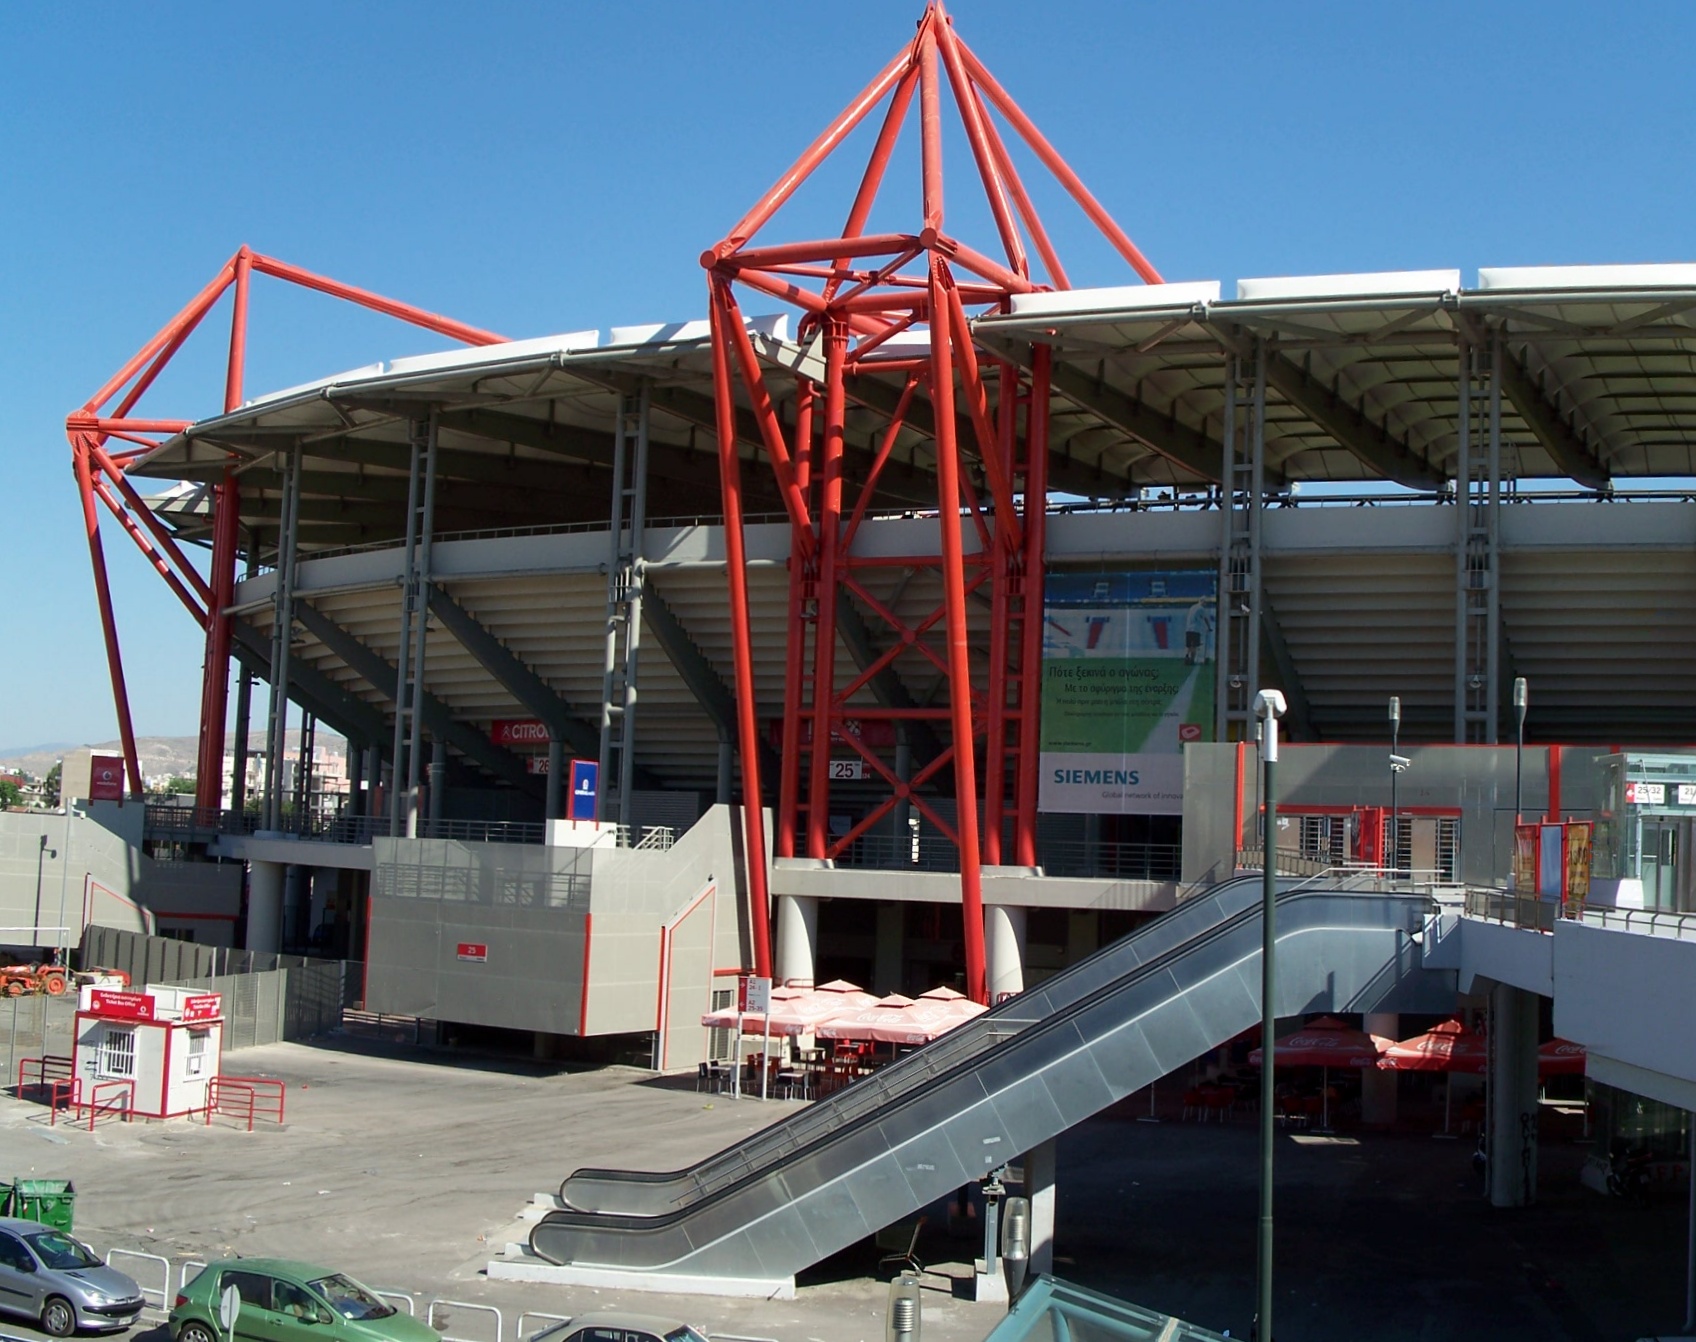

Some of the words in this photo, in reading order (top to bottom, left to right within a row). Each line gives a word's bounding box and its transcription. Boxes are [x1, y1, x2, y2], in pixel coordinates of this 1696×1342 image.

[1049, 666, 1072, 678] Πότε
[1076, 666, 1106, 680] ξεκινά
[836, 763, 854, 778] 25
[1054, 770, 1139, 785] SIEMENS
